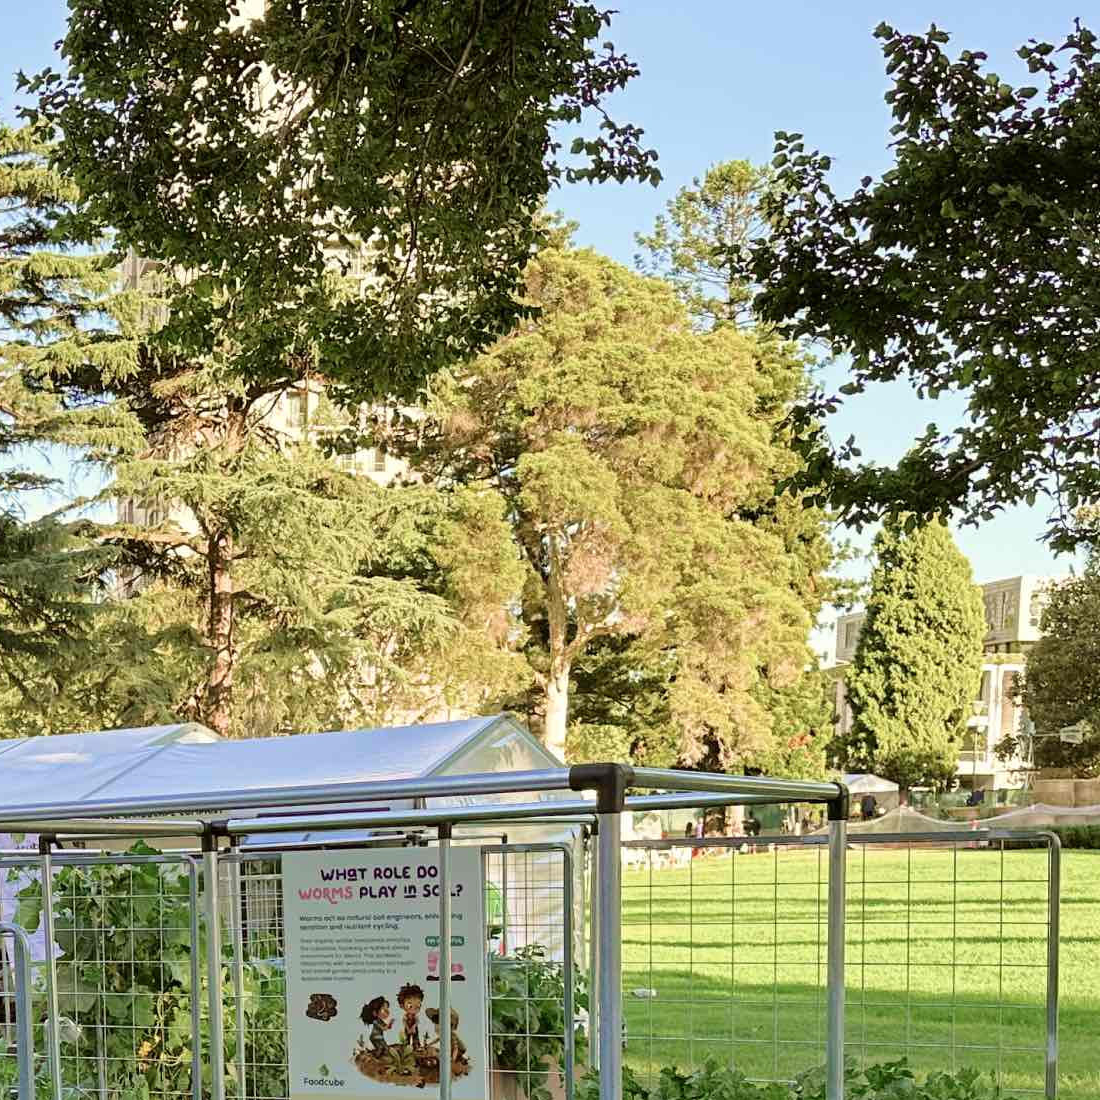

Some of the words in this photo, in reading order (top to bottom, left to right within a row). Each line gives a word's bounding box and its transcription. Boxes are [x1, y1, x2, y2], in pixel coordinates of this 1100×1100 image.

[373, 866, 411, 879] ROLE
[417, 865, 438, 878] DO
[298, 886, 353, 904] WORMS
[359, 885, 397, 899] PLAY
[422, 884, 463, 898] SO?
[303, 1077, 345, 1087] Foodcube
